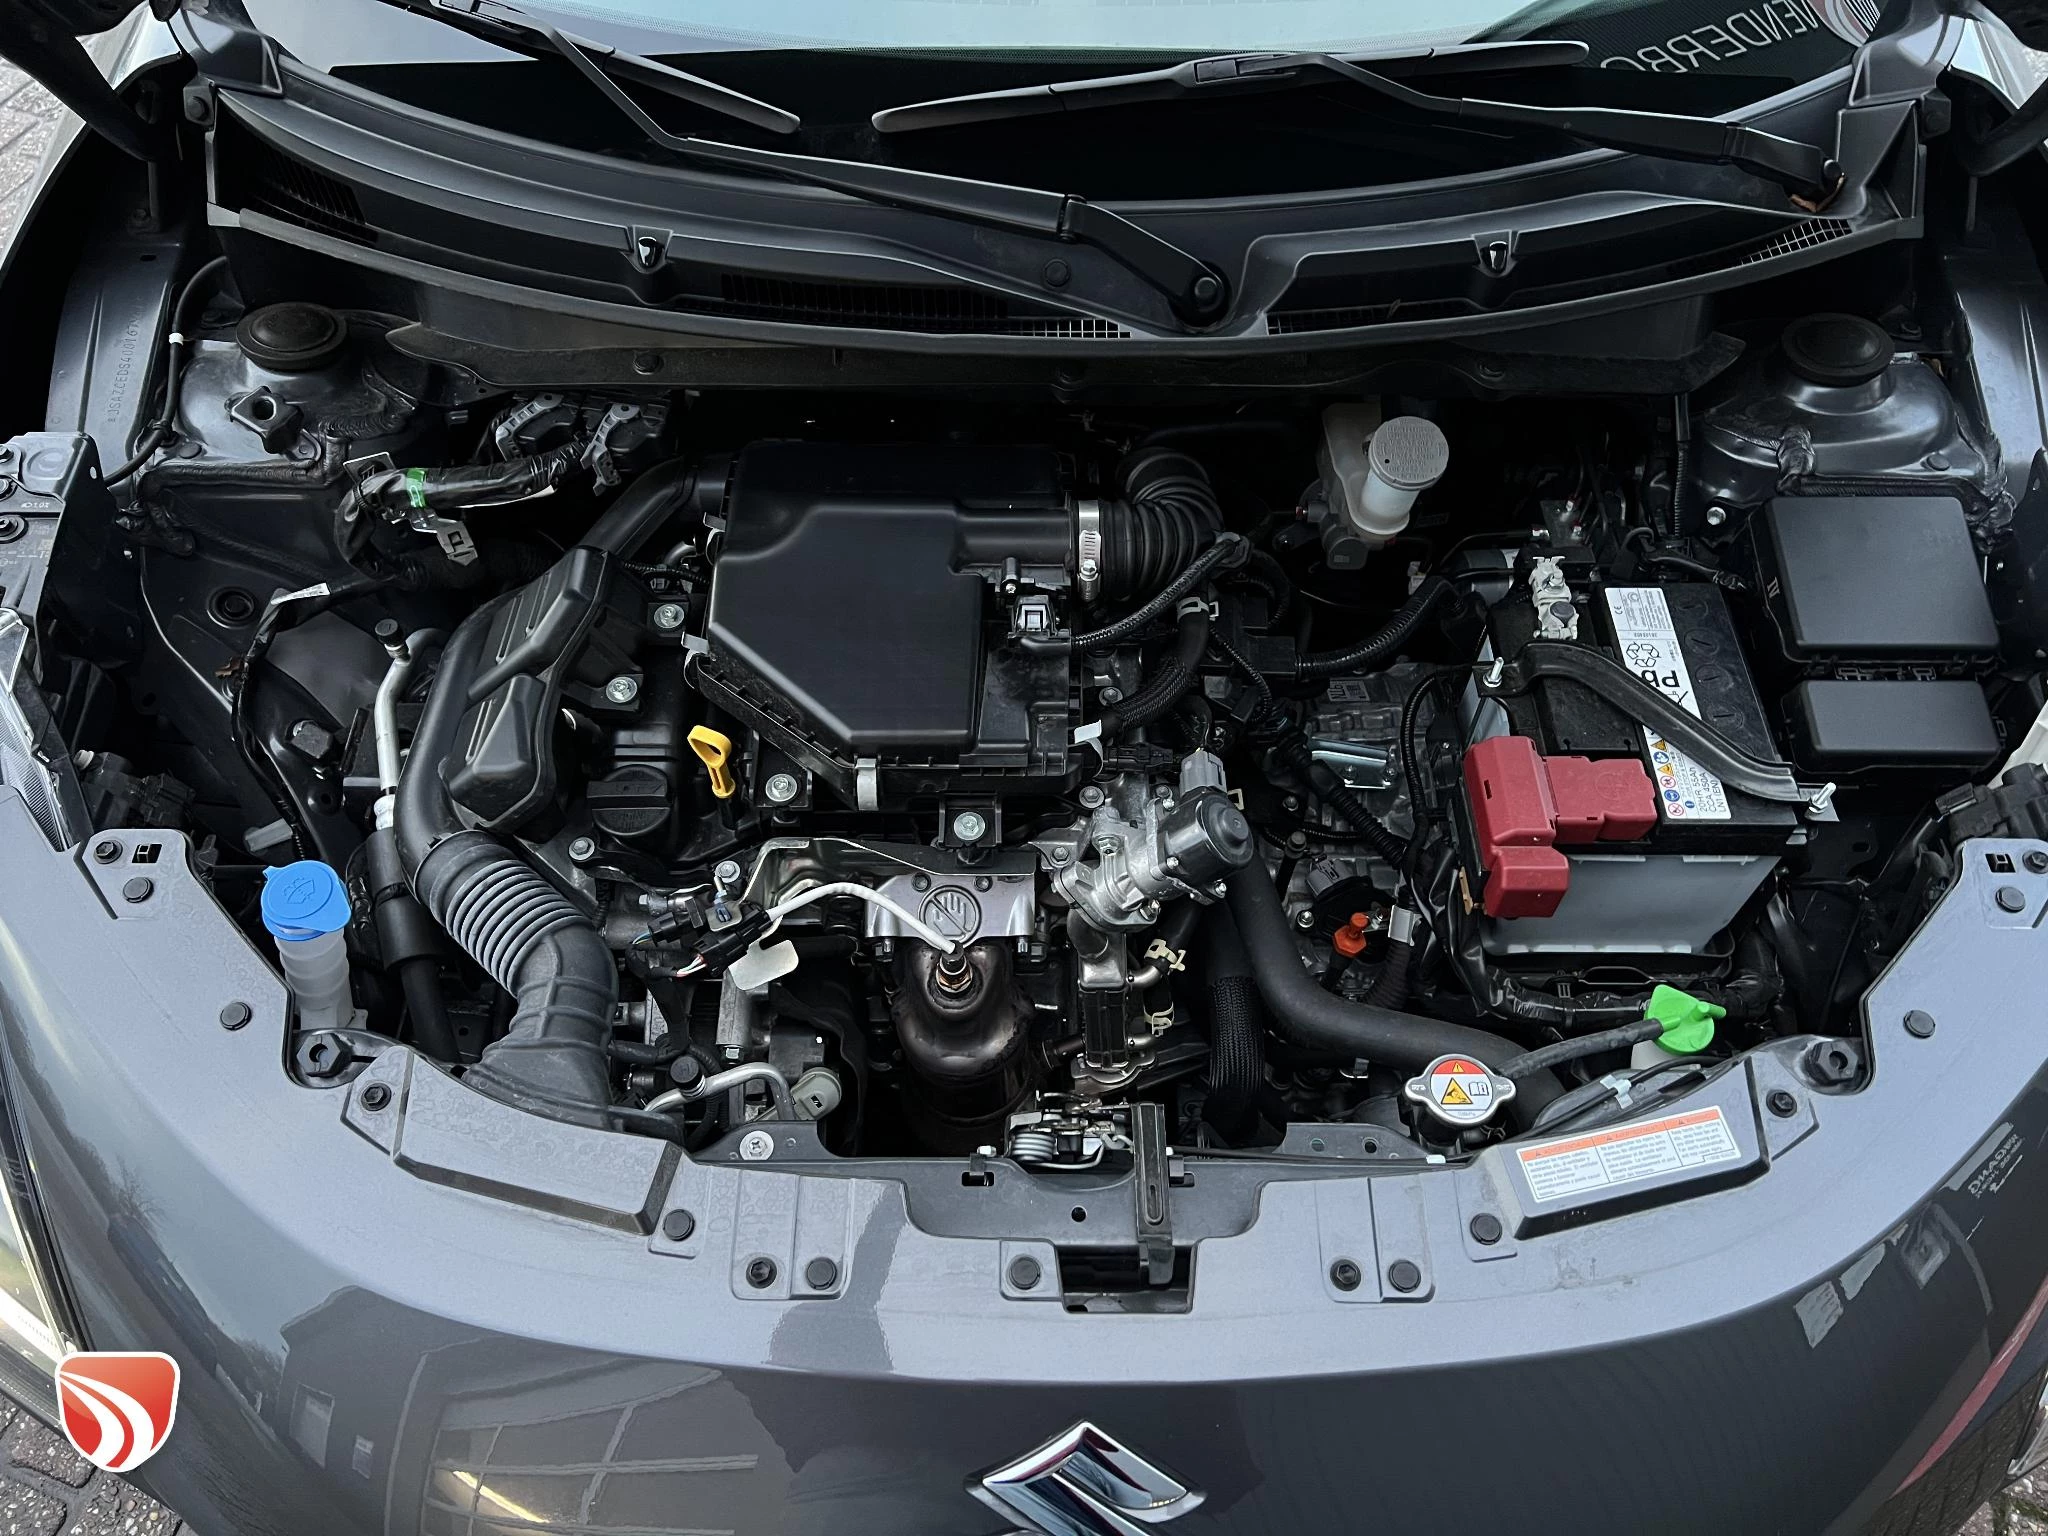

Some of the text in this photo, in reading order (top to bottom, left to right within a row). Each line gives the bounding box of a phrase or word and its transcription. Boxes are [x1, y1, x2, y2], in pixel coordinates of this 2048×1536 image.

[1640, 669, 1680, 688] Pb
[1689, 767, 1708, 812] 20HR 55Ah
[1700, 772, 1716, 813] CCA 450A
